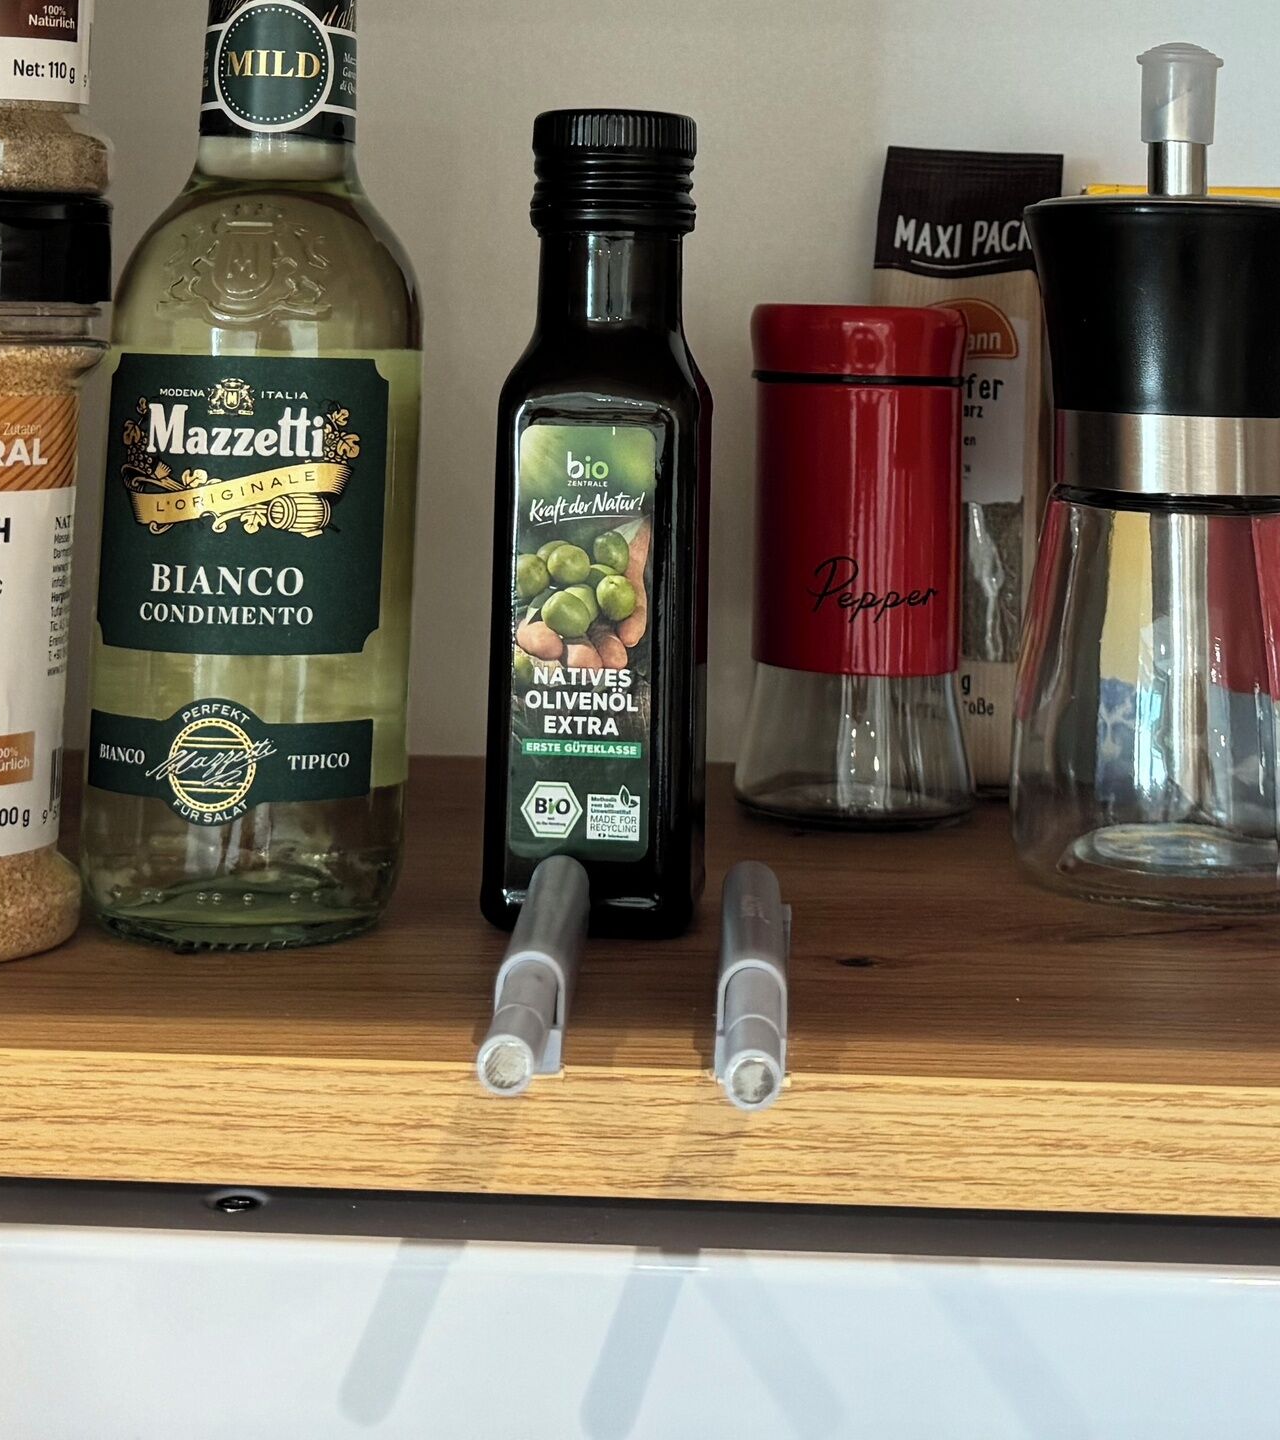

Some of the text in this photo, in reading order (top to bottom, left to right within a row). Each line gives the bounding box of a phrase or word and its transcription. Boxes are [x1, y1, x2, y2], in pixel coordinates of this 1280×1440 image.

[28, 15, 75, 30] Natürlich
[42, 5, 66, 16] 100%
[13, 59, 75, 84] Net: 110 g
[226, 50, 321, 79] MILD
[894, 215, 962, 259] MAXI
[160, 388, 308, 400] MODENA ITALIA
[2, 422, 42, 437] Zutaten
[146, 403, 324, 457] Mazzetti
[567, 451, 609, 478] bio
[156, 470, 316, 512] L'ORIGINALE
[529, 492, 646, 524] Kraft der Natur!
[150, 563, 304, 596] BIANCO
[808, 556, 938, 623] Pepper
[140, 602, 314, 626] CONDIMENTO
[533, 667, 632, 688] NATIVES
[525, 688, 639, 712] OLIVENÖL
[182, 704, 251, 724] PERFEKT
[544, 716, 619, 736] EXTRA
[99, 743, 145, 765] BIANCO
[288, 752, 350, 771] TIPICO
[526, 741, 637, 755] ERSTE GÜTEKLASSE
[22, 809, 30, 827] g
[204, 799, 248, 823] SALAT
[591, 815, 637, 824] MADE FOR
[590, 824, 637, 832] RECYCLING
